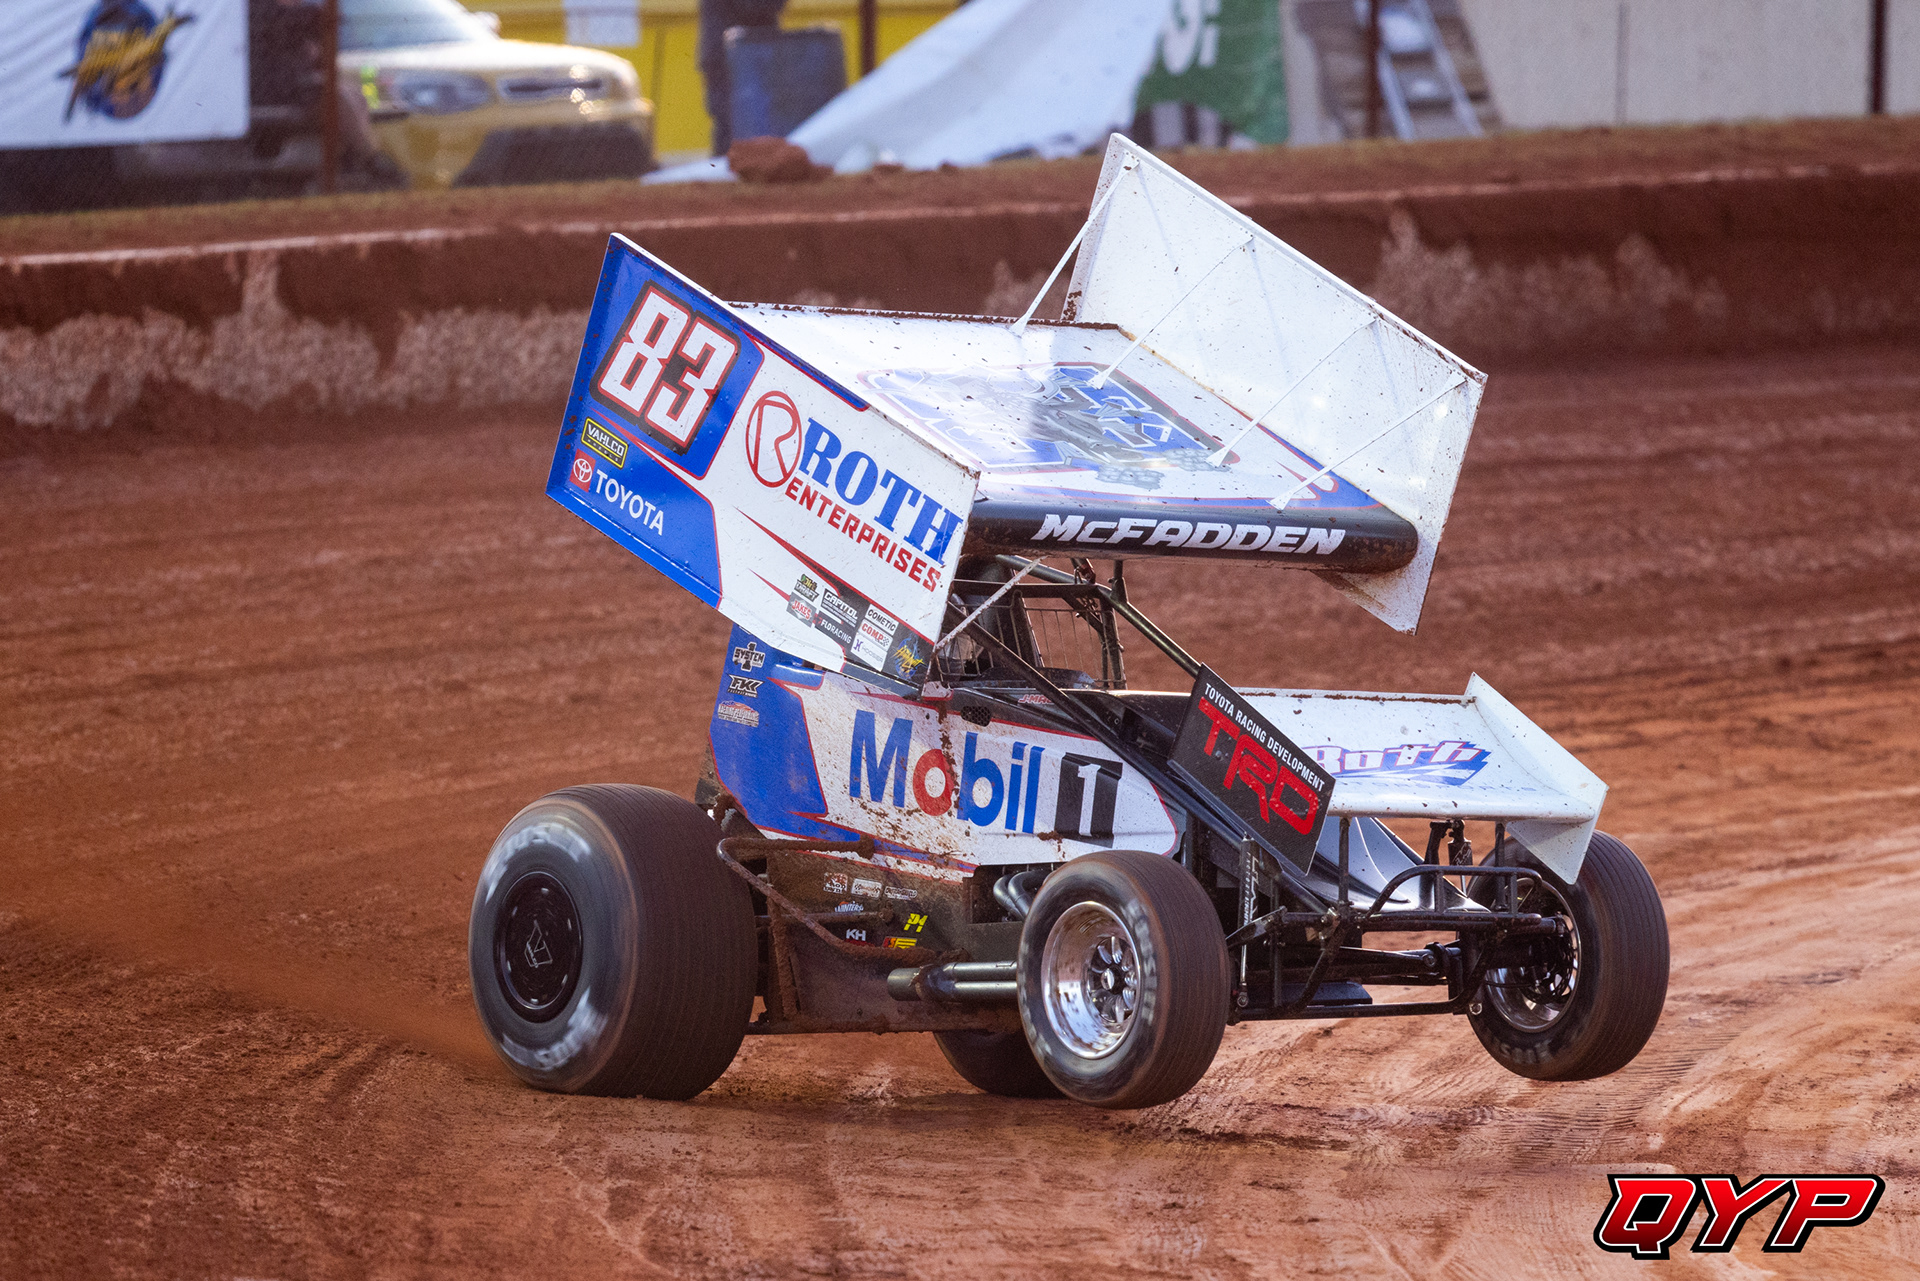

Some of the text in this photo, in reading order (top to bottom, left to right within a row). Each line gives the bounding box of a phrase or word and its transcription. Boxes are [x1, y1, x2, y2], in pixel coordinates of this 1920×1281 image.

[597, 286, 738, 449] 83
[588, 424, 625, 457] VAHLCO
[596, 469, 664, 536] TOYOTA
[799, 417, 964, 565] ROTH
[785, 476, 941, 592] ENTERPRISES
[791, 600, 812, 620] JAKES
[824, 592, 859, 620] CAPITOL
[861, 622, 884, 641] COMP
[867, 608, 896, 632] COMETIC
[734, 648, 765, 663] SYSTEM
[1204, 683, 1325, 792] TOYOTA RACING DEVELOPMENT
[1301, 740, 1485, 775] Roth
[850, 709, 1101, 838] Mobil 1
[1198, 697, 1319, 835] TRD
